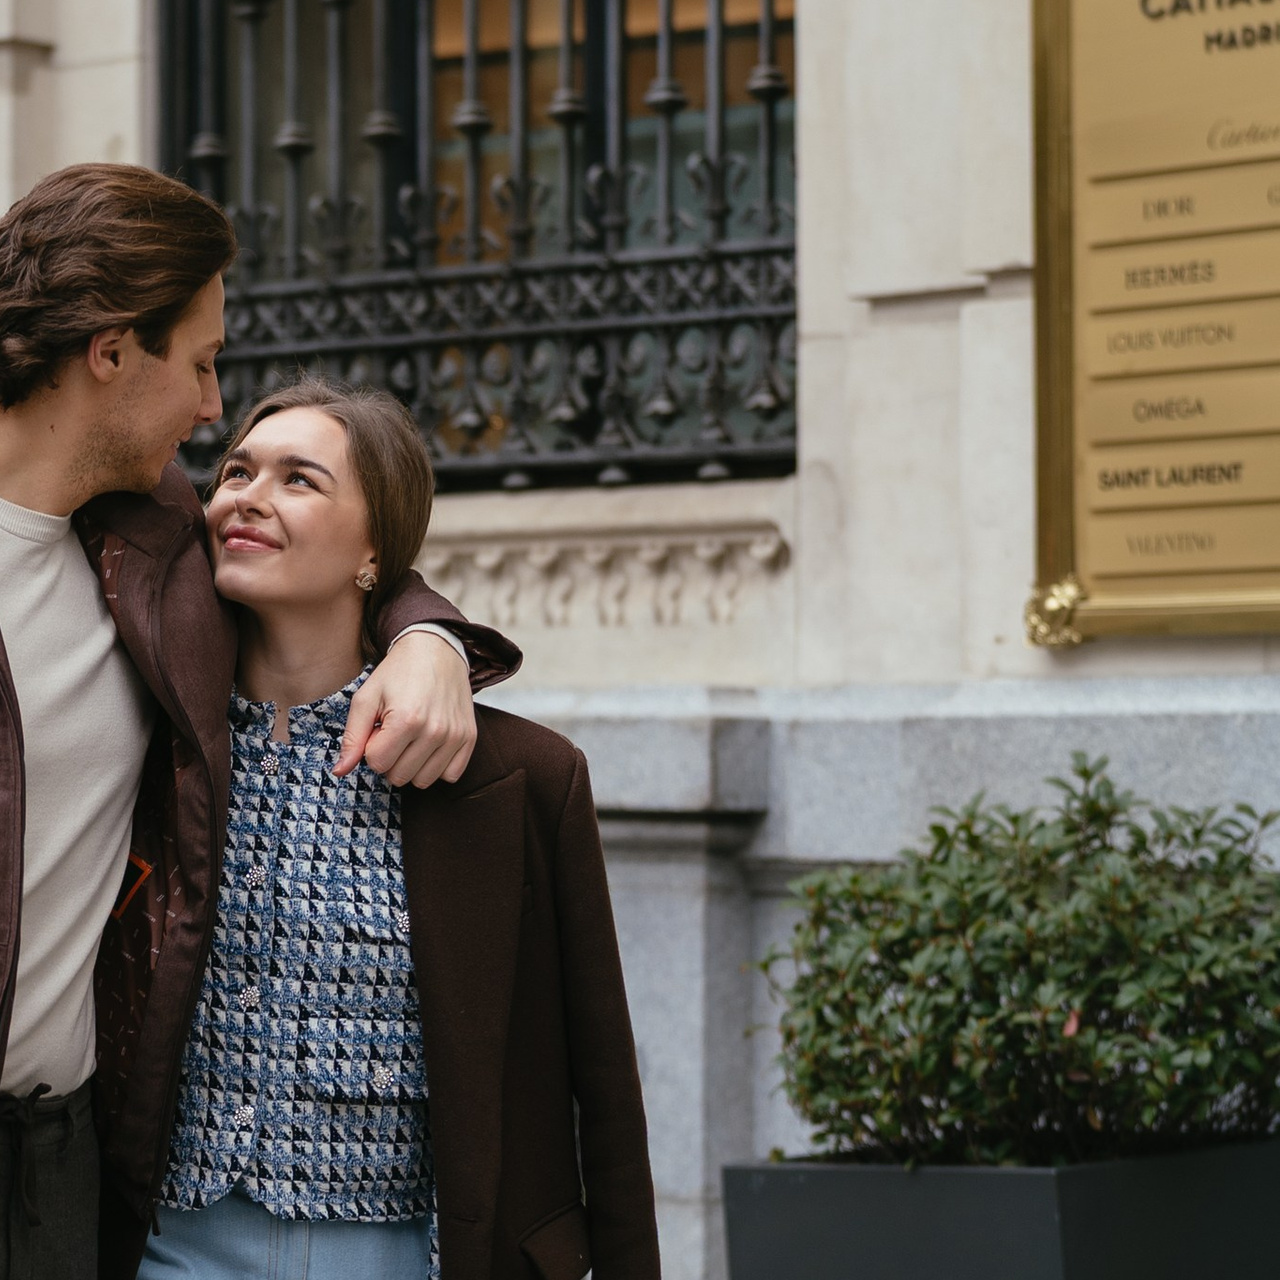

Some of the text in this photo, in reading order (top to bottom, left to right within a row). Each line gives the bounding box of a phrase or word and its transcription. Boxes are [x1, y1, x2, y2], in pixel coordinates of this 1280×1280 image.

[1107, 323, 1236, 355] LOUIS VUITTON
[1132, 397, 1206, 423] OMEGA
[1098, 461, 1243, 491] SAINT LAURENT
